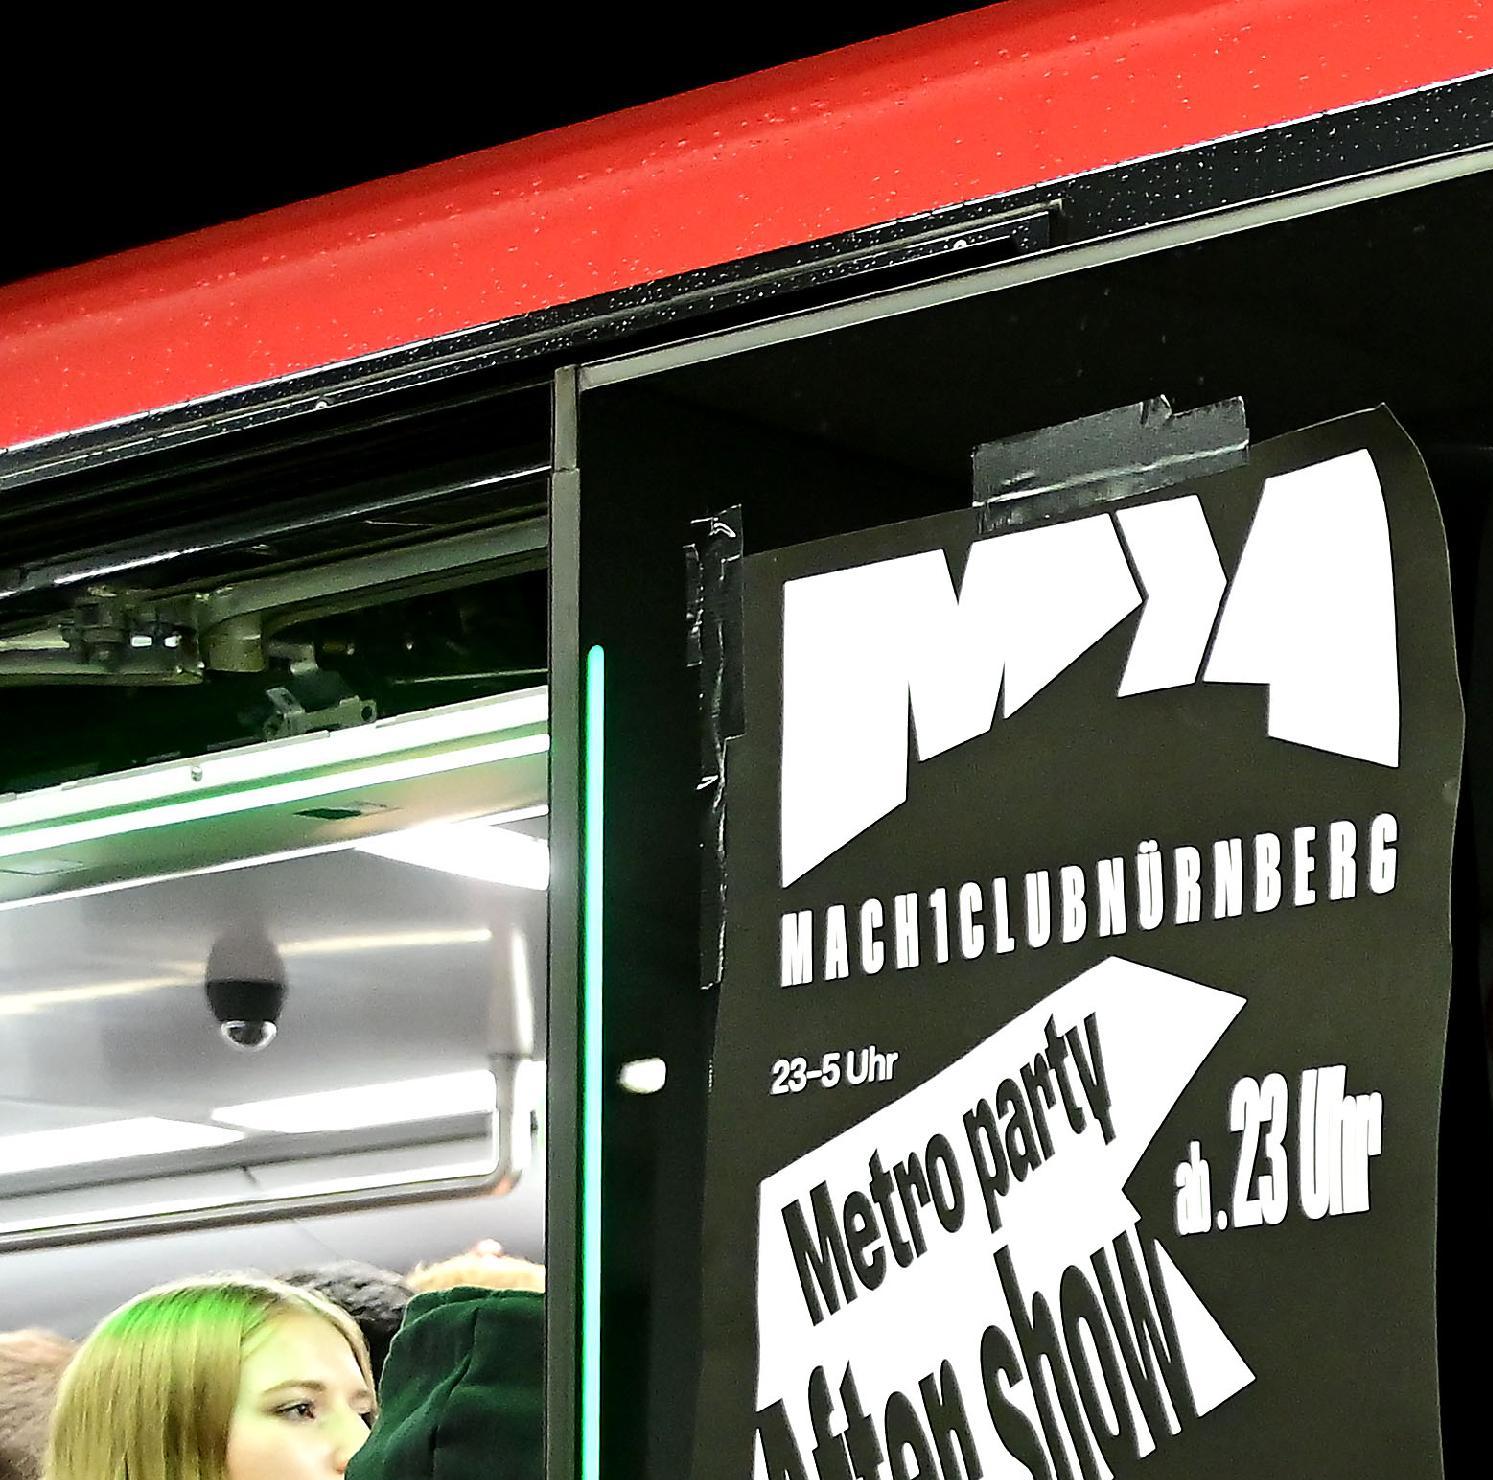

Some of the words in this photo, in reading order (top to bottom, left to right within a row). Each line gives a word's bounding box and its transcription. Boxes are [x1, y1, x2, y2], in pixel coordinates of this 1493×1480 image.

[846, 1045, 899, 1085] Uhr
[1230, 1072, 1288, 1228] 23
[1301, 1064, 1382, 1219] Uhr
[782, 1133, 965, 1326] Metro
[963, 1012, 1116, 1234] party
